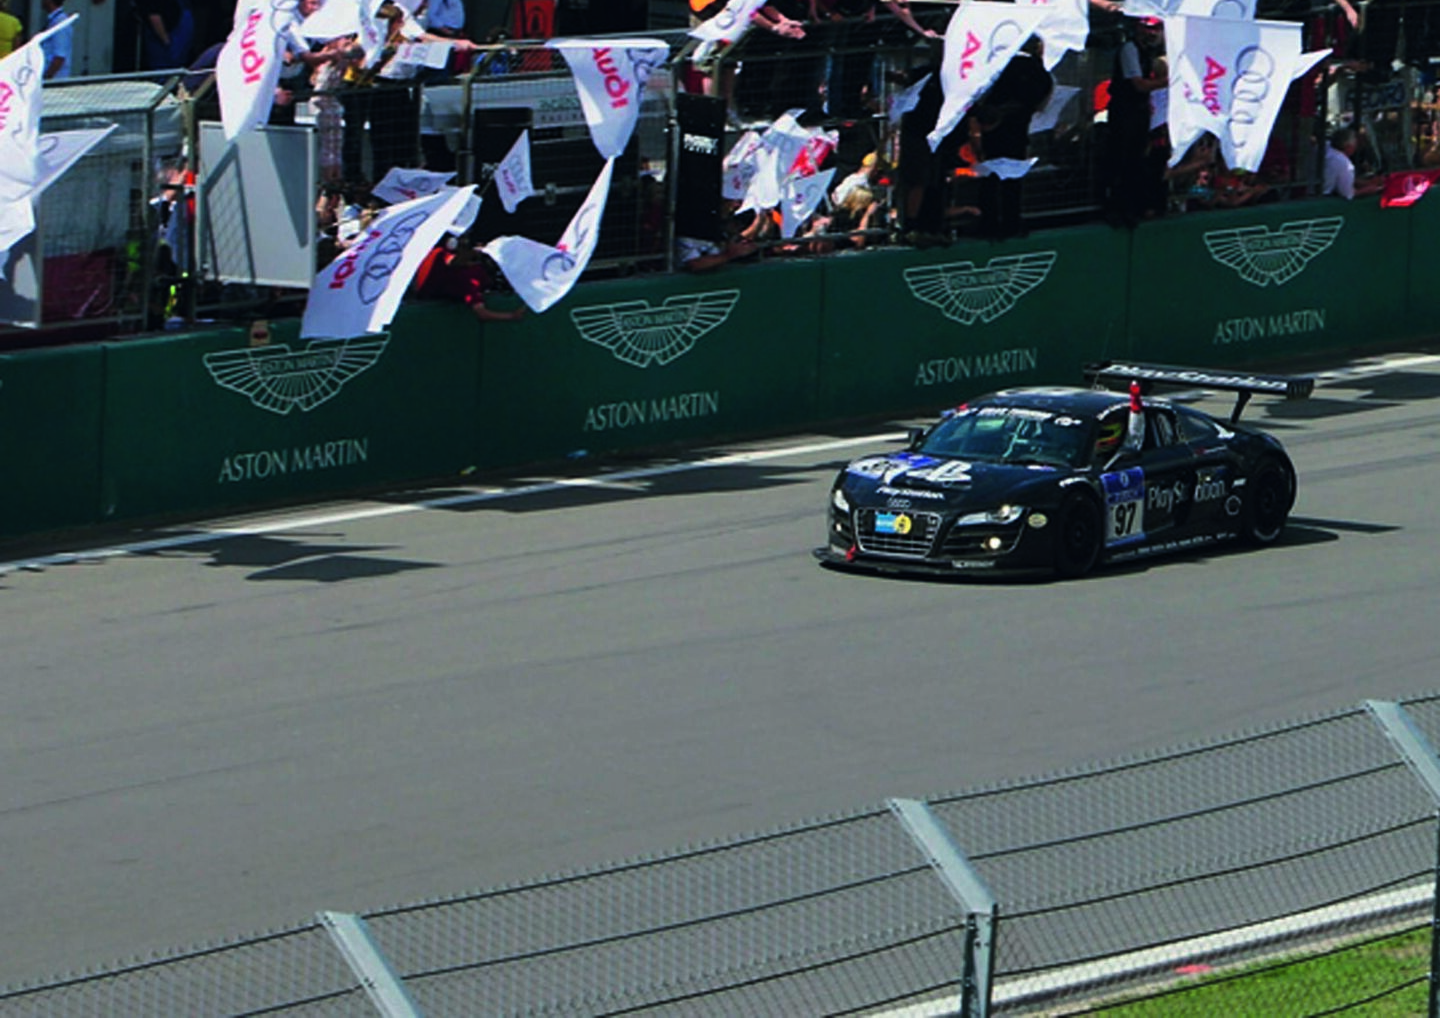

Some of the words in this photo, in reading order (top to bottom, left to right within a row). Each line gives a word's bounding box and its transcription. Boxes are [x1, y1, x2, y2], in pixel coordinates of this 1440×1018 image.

[1213, 316, 1264, 344] ASTON
[1267, 309, 1326, 337] MARTIN
[914, 357, 971, 386] ASTON
[974, 348, 1038, 377] MARTIN
[584, 399, 646, 432] ASTON
[649, 391, 720, 422] MARTIN
[218, 448, 288, 484] ASTON
[290, 439, 368, 473] MARTIN
[1114, 502, 1137, 536] 97
